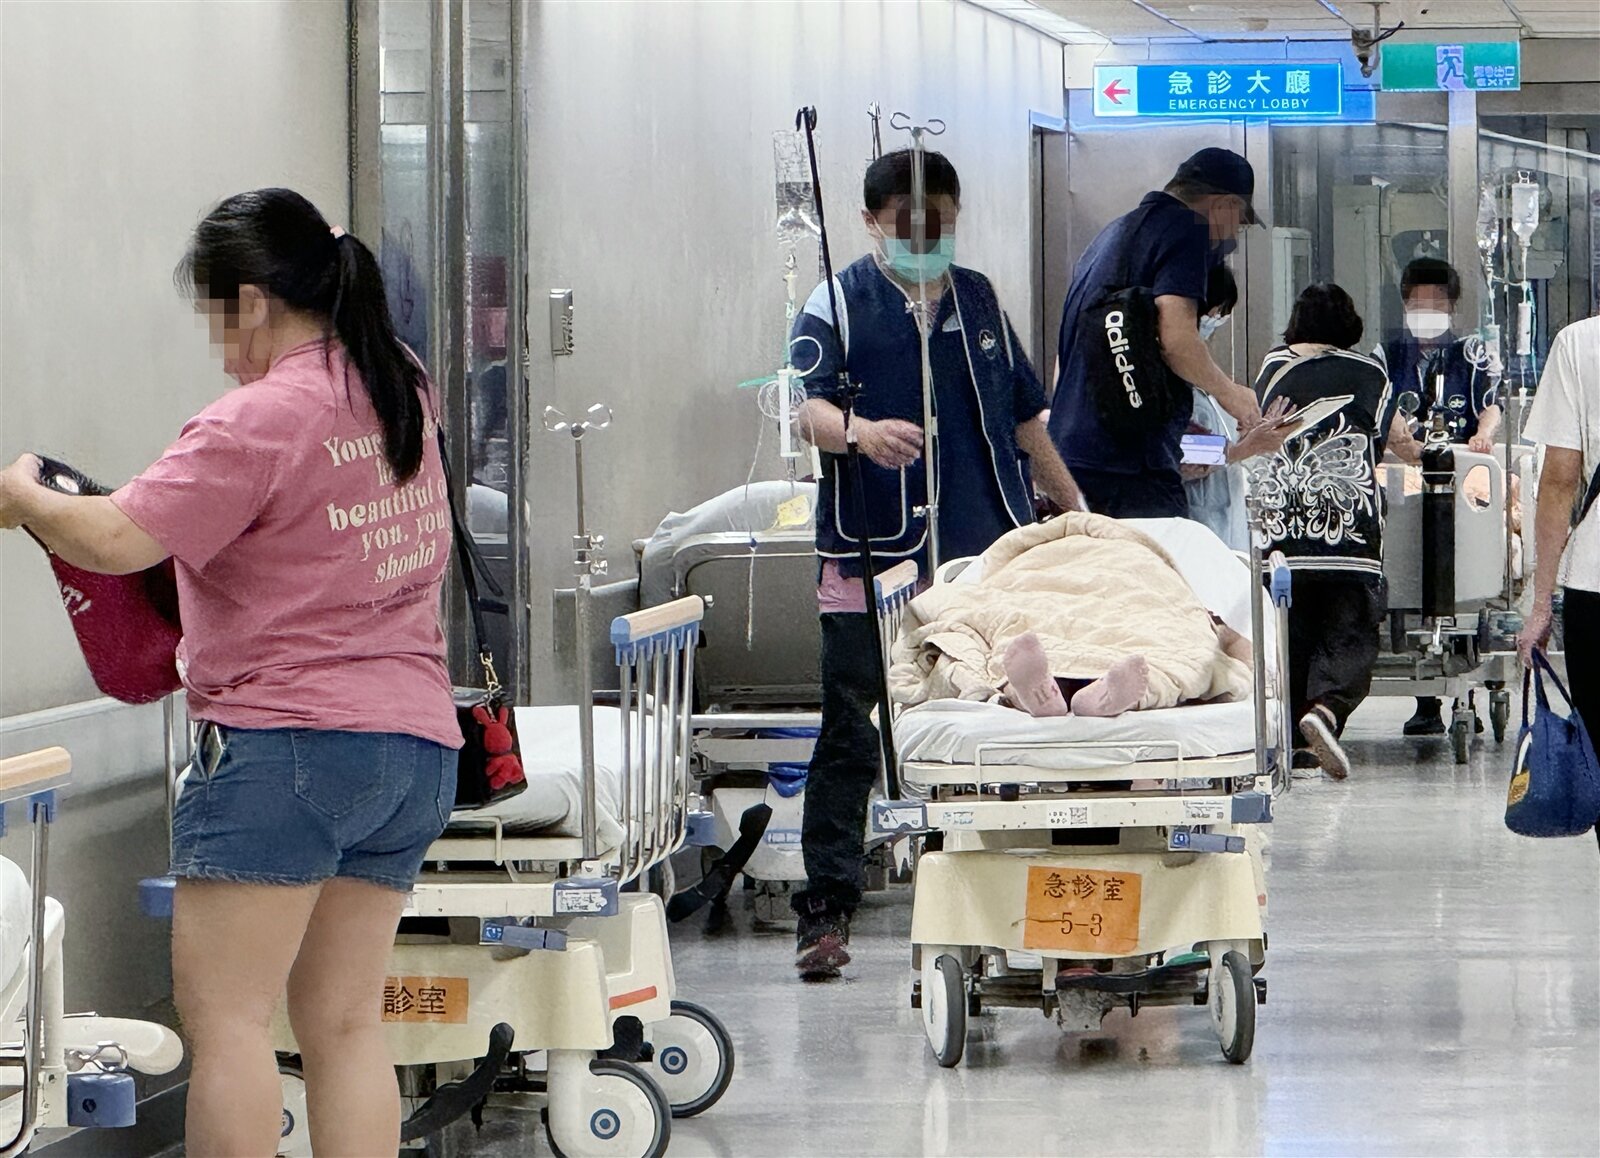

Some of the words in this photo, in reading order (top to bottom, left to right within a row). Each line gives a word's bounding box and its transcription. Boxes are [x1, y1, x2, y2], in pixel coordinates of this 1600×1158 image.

[1168, 69, 1310, 94] 急診大廳
[1169, 99, 1257, 110] EMERGENCY
[1262, 98, 1310, 109] LOBBY
[1105, 310, 1143, 409] adidas
[326, 476, 434, 532] beautiful
[371, 537, 436, 584] should
[1043, 872, 1126, 902] 急診室
[1060, 911, 1104, 937] 5-3
